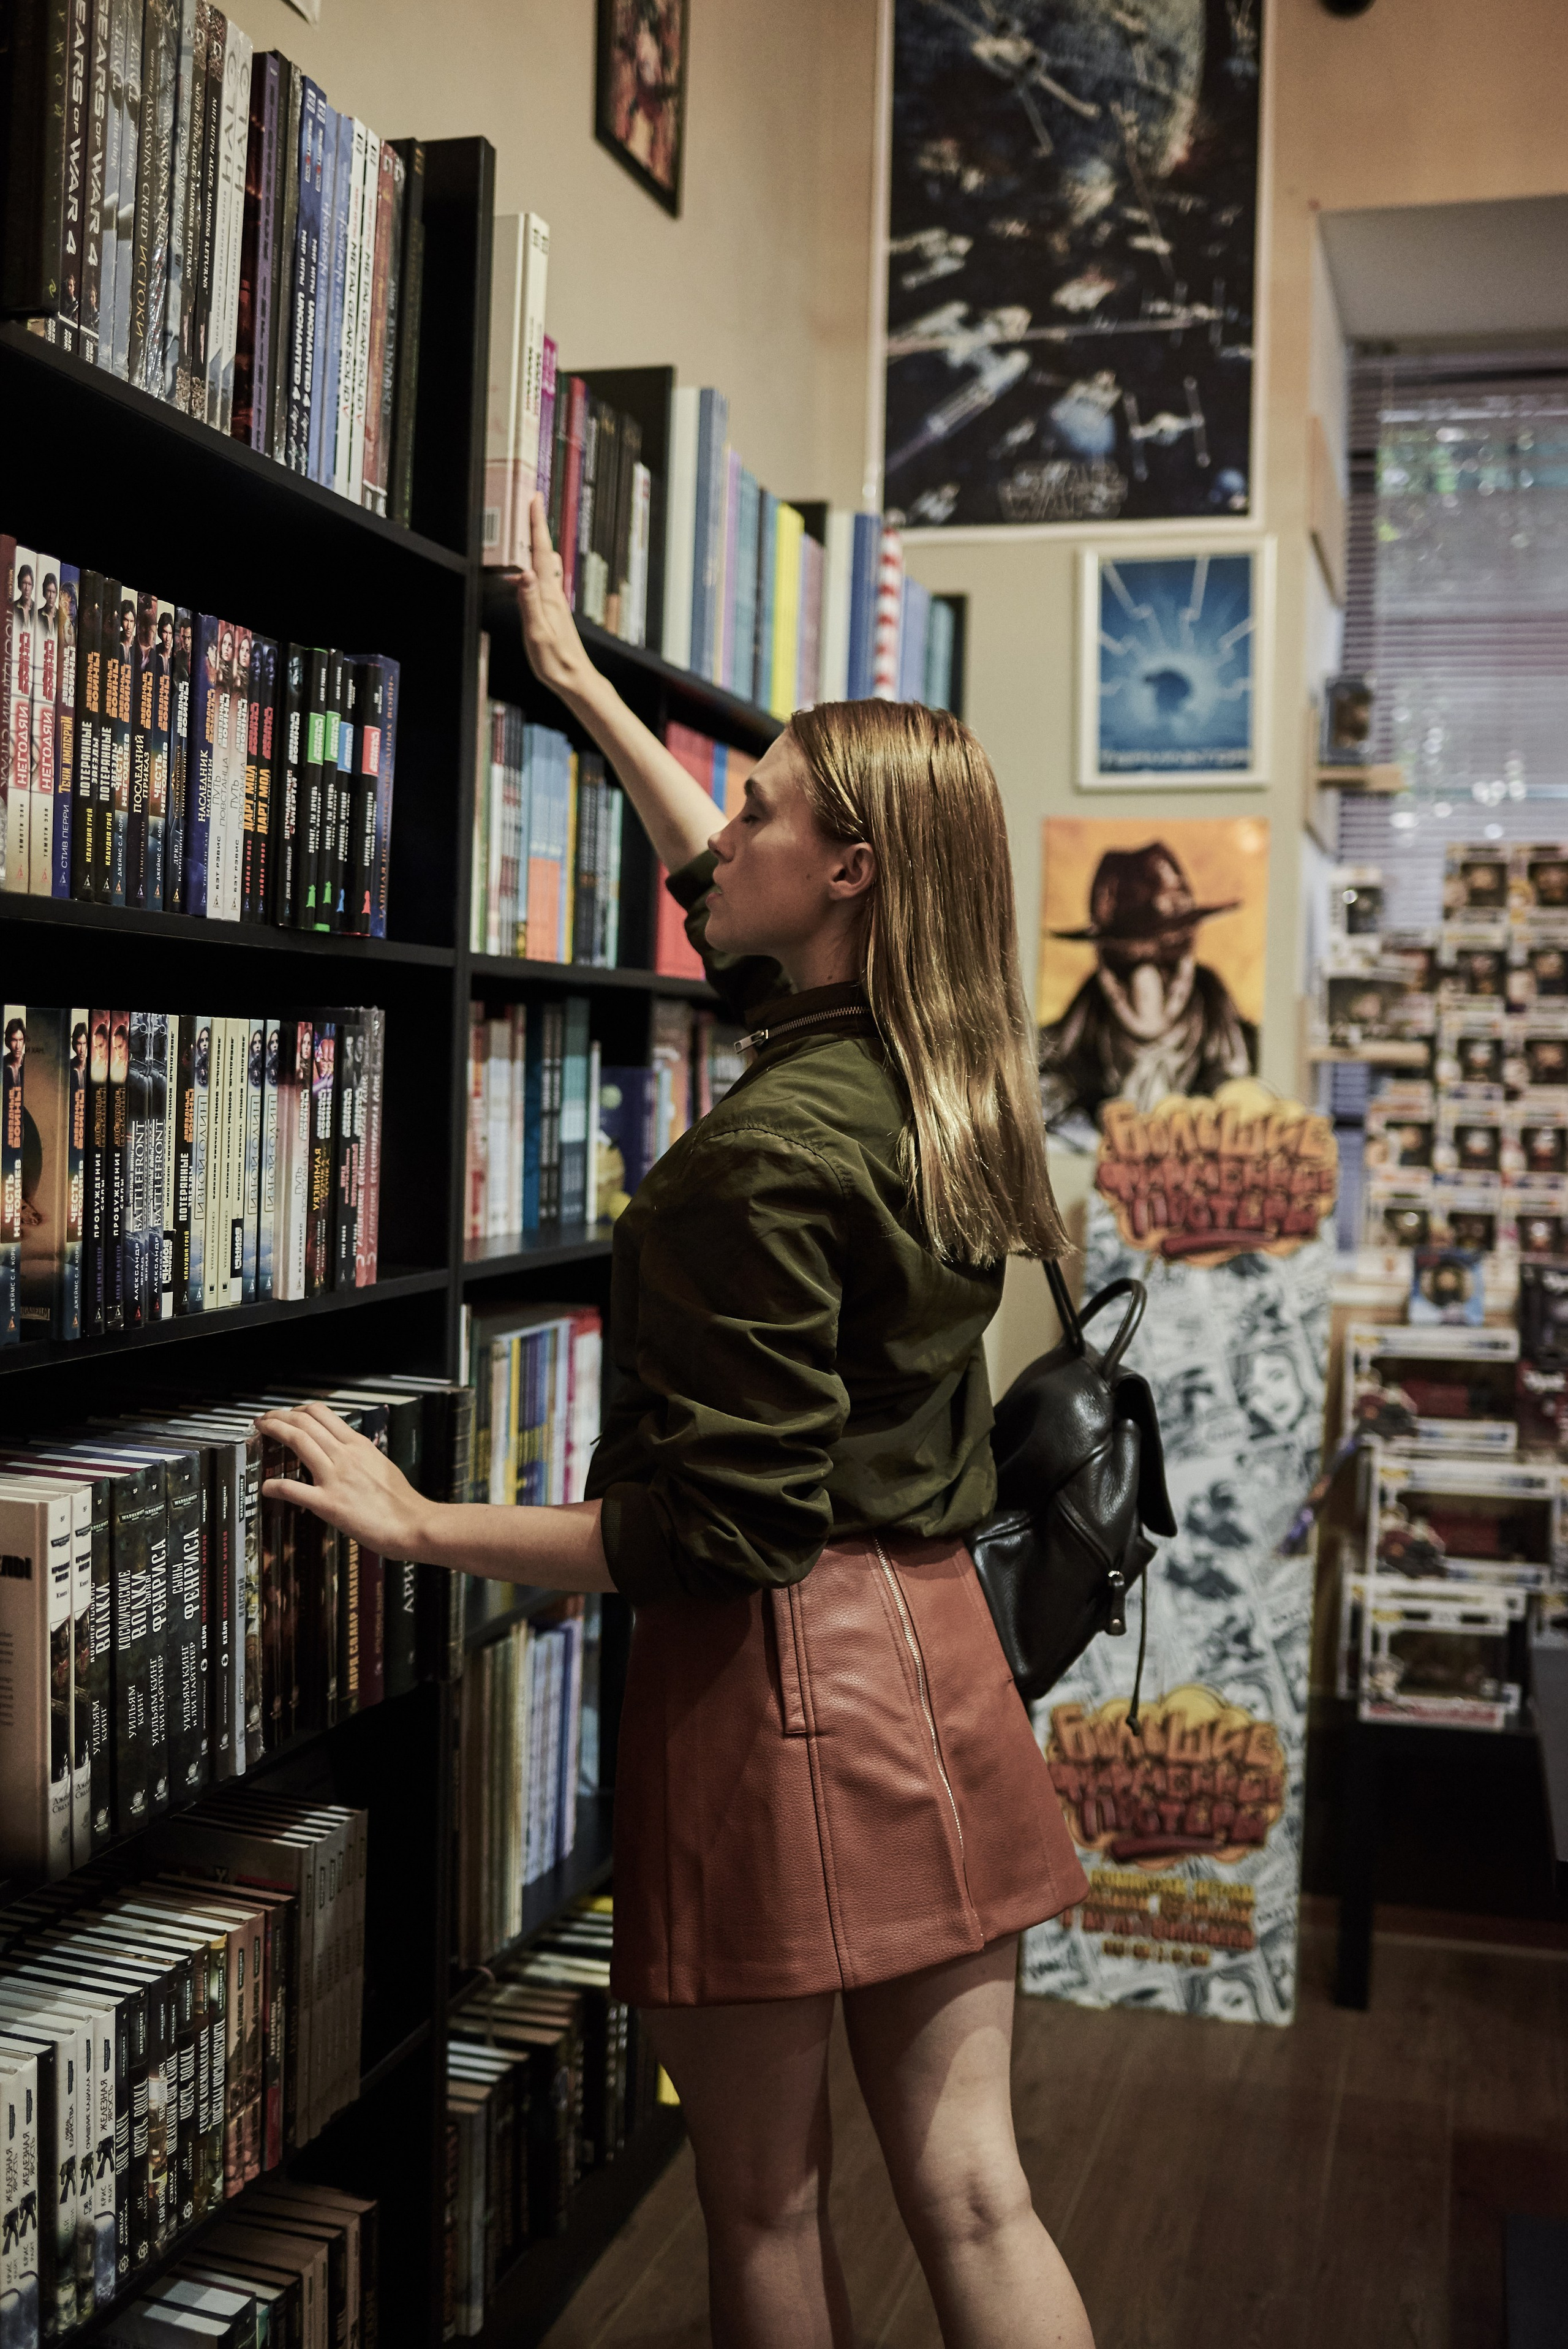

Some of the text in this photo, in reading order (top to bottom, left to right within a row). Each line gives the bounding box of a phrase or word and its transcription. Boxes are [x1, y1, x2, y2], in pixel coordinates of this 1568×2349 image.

[74, 107, 80, 134] OF
[96, 122, 102, 149] OF
[222, 50, 236, 183] HALO
[235, 61, 250, 194] HALO
[67, 138, 81, 222] WAR
[89, 152, 102, 234] WAR
[187, 183, 197, 229] MADNESS
[204, 190, 213, 238] MADNESS
[66, 230, 77, 255] 4
[88, 243, 98, 266] 4
[175, 203, 184, 246] CREED
[136, 244, 148, 337] ИСТОКИ
[202, 240, 211, 288] RETURNS
[292, 292, 305, 401] UNCHARTED 4
[303, 300, 315, 408] UNCHARTED 4
[341, 241, 357, 403] METAL GEAR SOLID
[355, 252, 371, 411] METAL GEAR SOLID
[18, 705, 29, 786] НЕГОДЯИ
[43, 711, 53, 791] НЕГОДЯИ
[80, 720, 92, 797] ПОТЕРЯННЫЕ
[99, 726, 111, 802] ПОТЕРЯННЫЕ
[115, 745, 123, 791] ЧЕСТЬ
[121, 733, 130, 807] НЕГОДЯЕВ
[134, 734, 145, 813] ПОСЛЕДНИЙ
[154, 753, 162, 798] ЧЕСТЬ
[160, 741, 168, 814] НЕГОДЯЕВ
[198, 750, 208, 823] НАСЛЕДНИК
[212, 775, 221, 805] ПУТЬ
[220, 758, 228, 827] ПОВСТАНЦА
[230, 780, 239, 809] ПУТЬ
[244, 765, 257, 832] ДАРТ МОЛ
[257, 769, 270, 835] ДАРТ МОЛ
[133, 1120, 145, 1232] BATTLEFRONT
[154, 1118, 164, 1226] BATTLEFRONT
[179, 1152, 189, 1221] ПОТЕРЯННЫЕ
[195, 1101, 208, 1214] ИЗГОЙ-ОДИН
[249, 1101, 260, 1210] ИЗГОЙ-ОДИН
[295, 1167, 303, 1195] ПУТЬ
[313, 1147, 322, 1211] УЯЗВИМАЯ
[5, 1174, 14, 1223] ЧЕСТЬ
[13, 1159, 22, 1237] НЕГОДЯЕВ
[131, 1569, 147, 1640] ВОЛКИ
[151, 1538, 167, 1633] ФЕНРИСА
[172, 1563, 183, 1594] СЫНЫ
[184, 1527, 200, 1620] ФЕНРИСА
[402, 1561, 415, 1614] АРИ
[96, 1582, 110, 1654] ВОЛКИ
[118, 1570, 131, 1651] КОСМИЧЕСКИЕ
[349, 1612, 359, 1654] СОЛАР
[183, 1680, 192, 1732] УИЛЬЯМ
[349, 1656, 359, 1691] ЛОРД
[128, 1684, 137, 1739] УИЛЬЯМ
[159, 1716, 165, 1731] ЛИ
[191, 1702, 197, 1717] ЛИ
[158, 2062, 167, 2076] МЕЧ
[179, 2043, 195, 2121] ЧЕСТЬ ВОЛКА
[116, 2111, 129, 2174] ЗОВ ДОЛГА
[133, 2077, 149, 2158] ЧЕСТЬ ВОЛКА
[4, 2147, 13, 2204] ЖЕЛЕЗНАЯ
[22, 2131, 31, 2187] ЖЕЛЕЗНАЯ
[158, 2206, 167, 2223] ГАЙ
